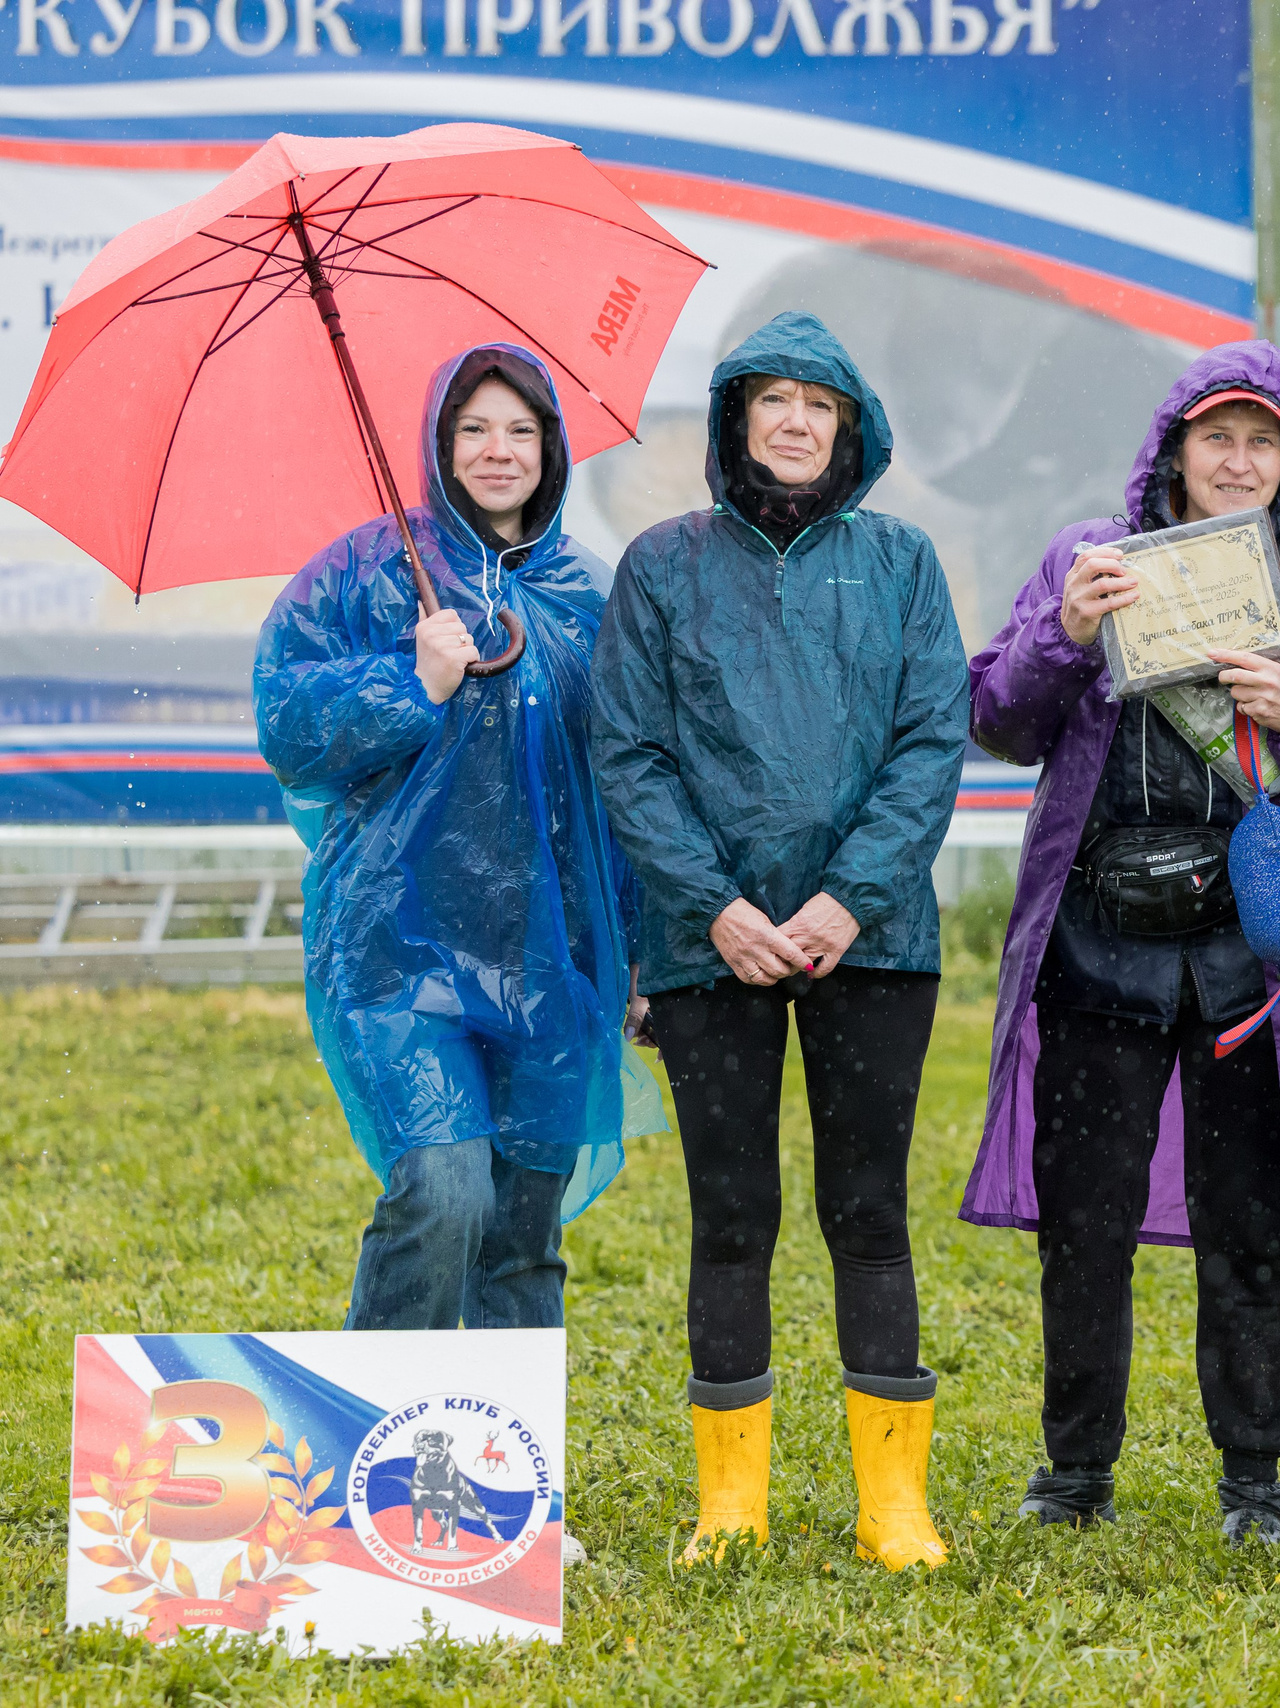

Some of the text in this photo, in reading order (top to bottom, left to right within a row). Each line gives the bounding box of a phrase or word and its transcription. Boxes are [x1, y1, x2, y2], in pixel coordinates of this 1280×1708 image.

[401, 0, 1098, 56] ПРИВОЛЖЬЯ
[1138, 609, 1242, 647] Лучшая собака ПРК
[1146, 852, 1176, 862] SPORT
[145, 1379, 271, 1542] 3
[353, 1398, 550, 1502] РОТВЕЙЛЕР КЛУБ РОССИИ
[365, 1529, 537, 1585] НИЖЕГОРОДСКОЕ РО
